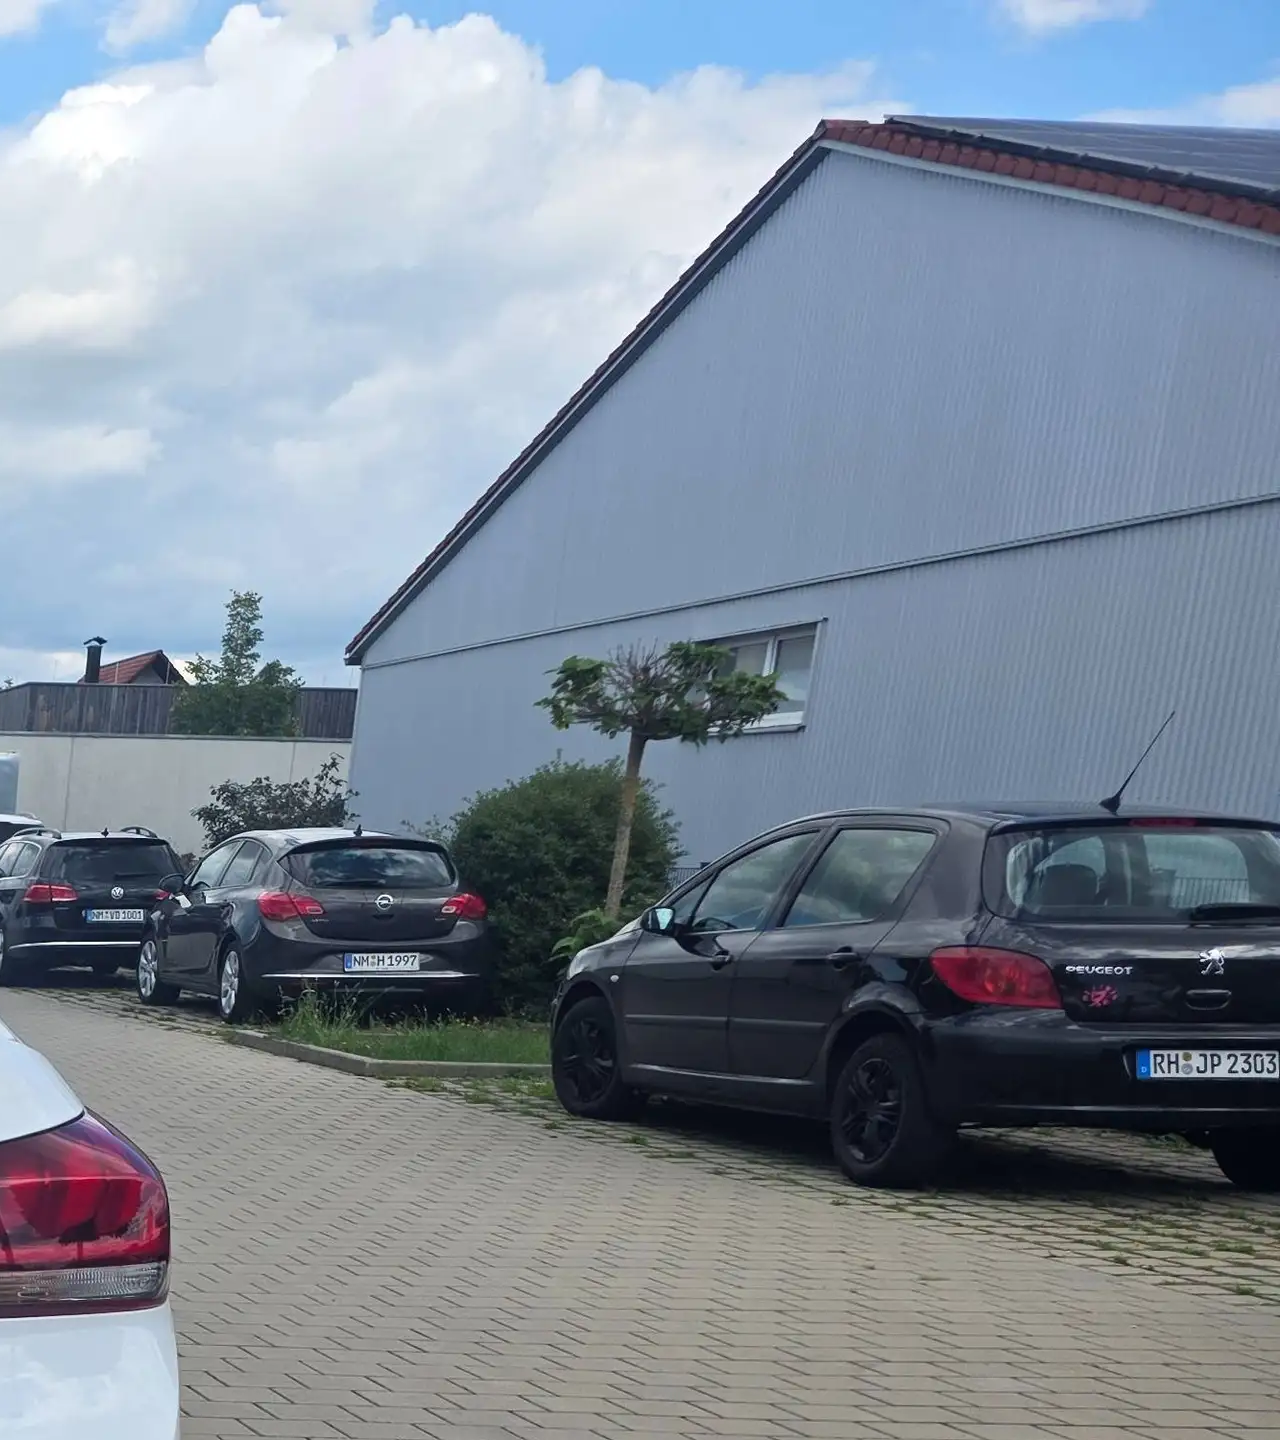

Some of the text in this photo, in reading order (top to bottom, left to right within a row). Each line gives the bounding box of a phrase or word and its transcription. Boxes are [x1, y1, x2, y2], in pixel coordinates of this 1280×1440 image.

[353, 954, 417, 967] NM H 1997
[1065, 964, 1133, 976] PEUGEOT
[1153, 1053, 1277, 1074] RH JP 2303
